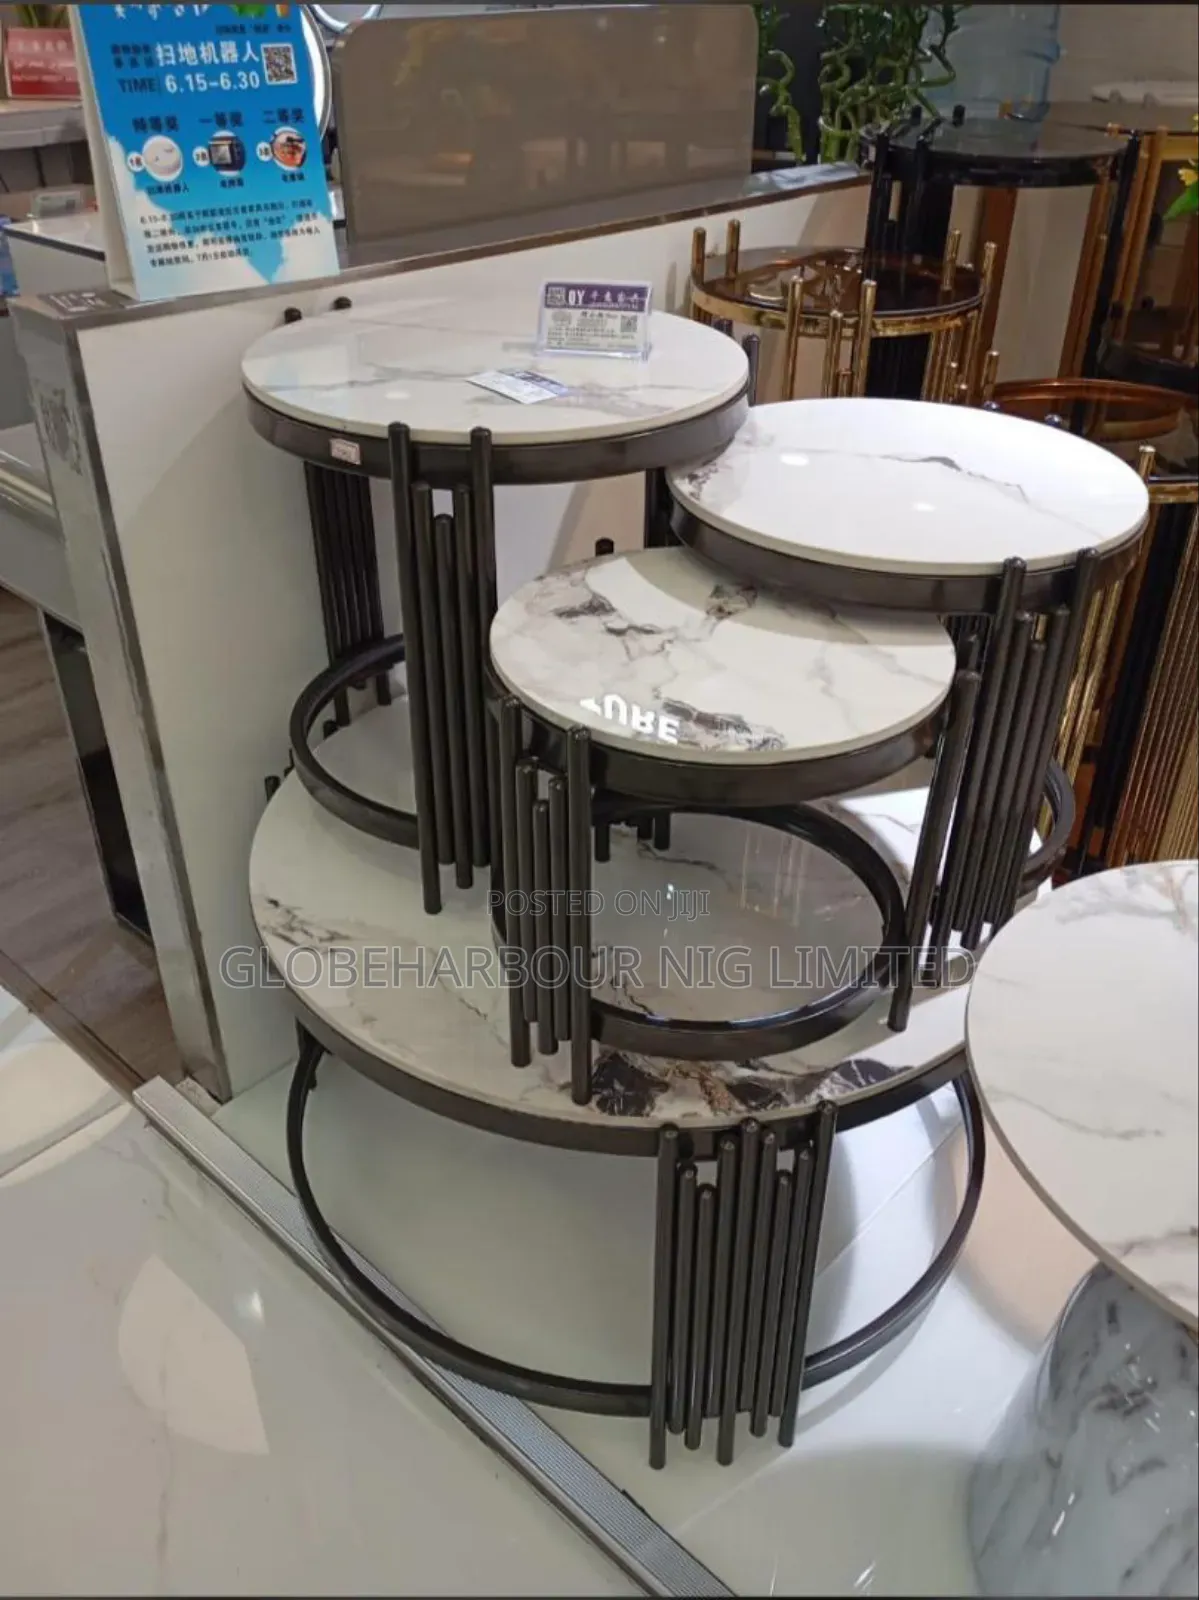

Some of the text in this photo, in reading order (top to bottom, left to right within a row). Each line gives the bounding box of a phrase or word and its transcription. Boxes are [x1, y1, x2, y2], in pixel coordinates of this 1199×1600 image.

[155, 41, 260, 67] 扫地机器人
[164, 71, 261, 95] 6.15-6.30
